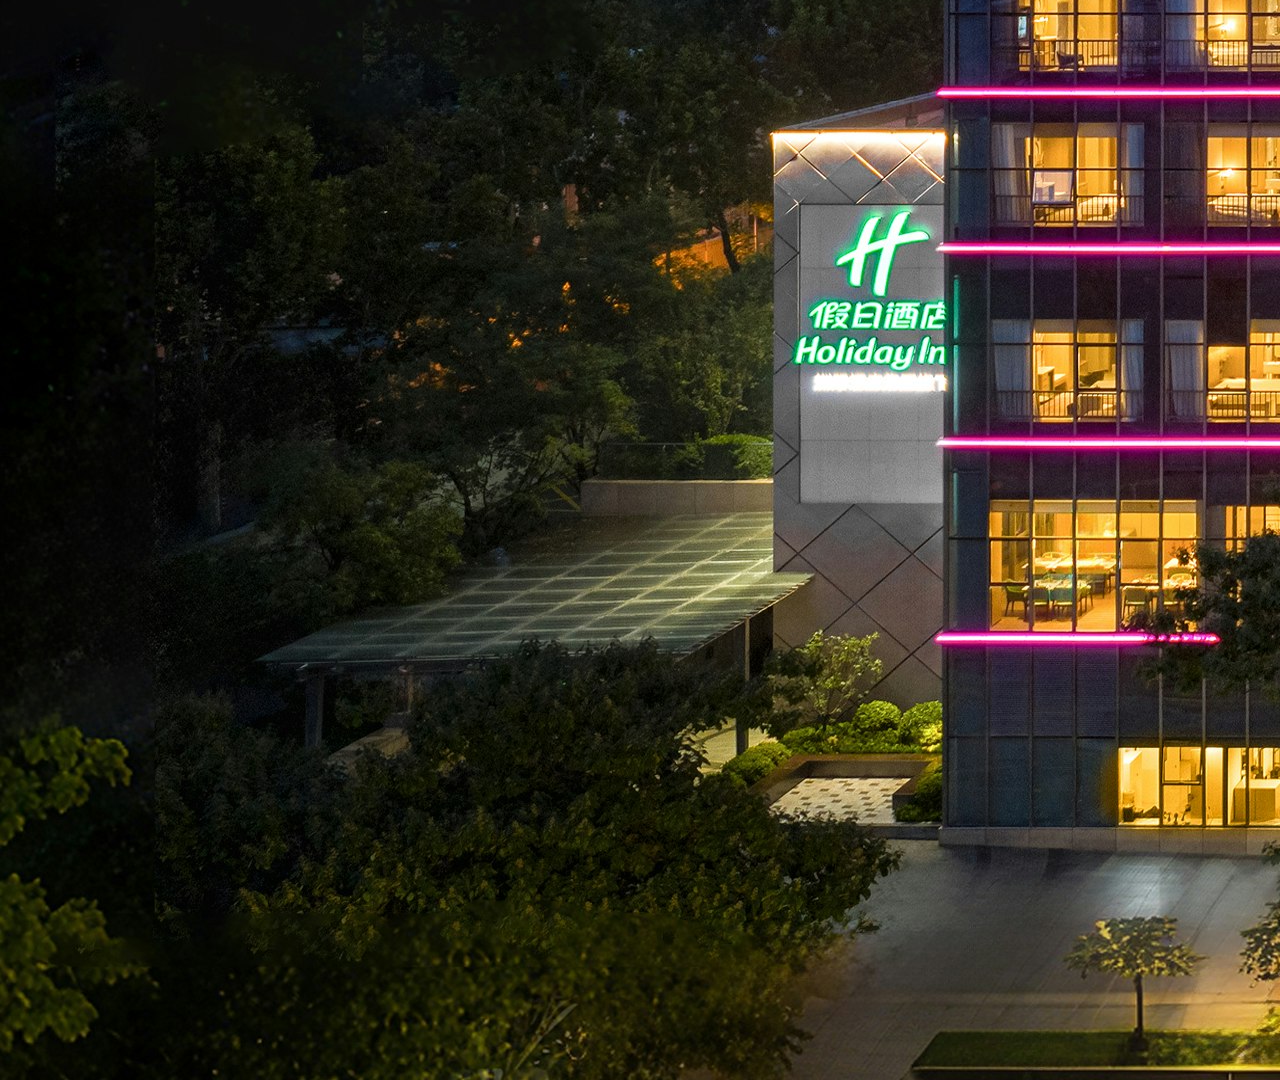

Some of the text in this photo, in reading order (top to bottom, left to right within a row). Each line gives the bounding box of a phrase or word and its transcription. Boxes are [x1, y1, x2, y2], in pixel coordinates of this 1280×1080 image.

[808, 301, 947, 330] 假日酒店
[794, 335, 947, 371] Holiday In
